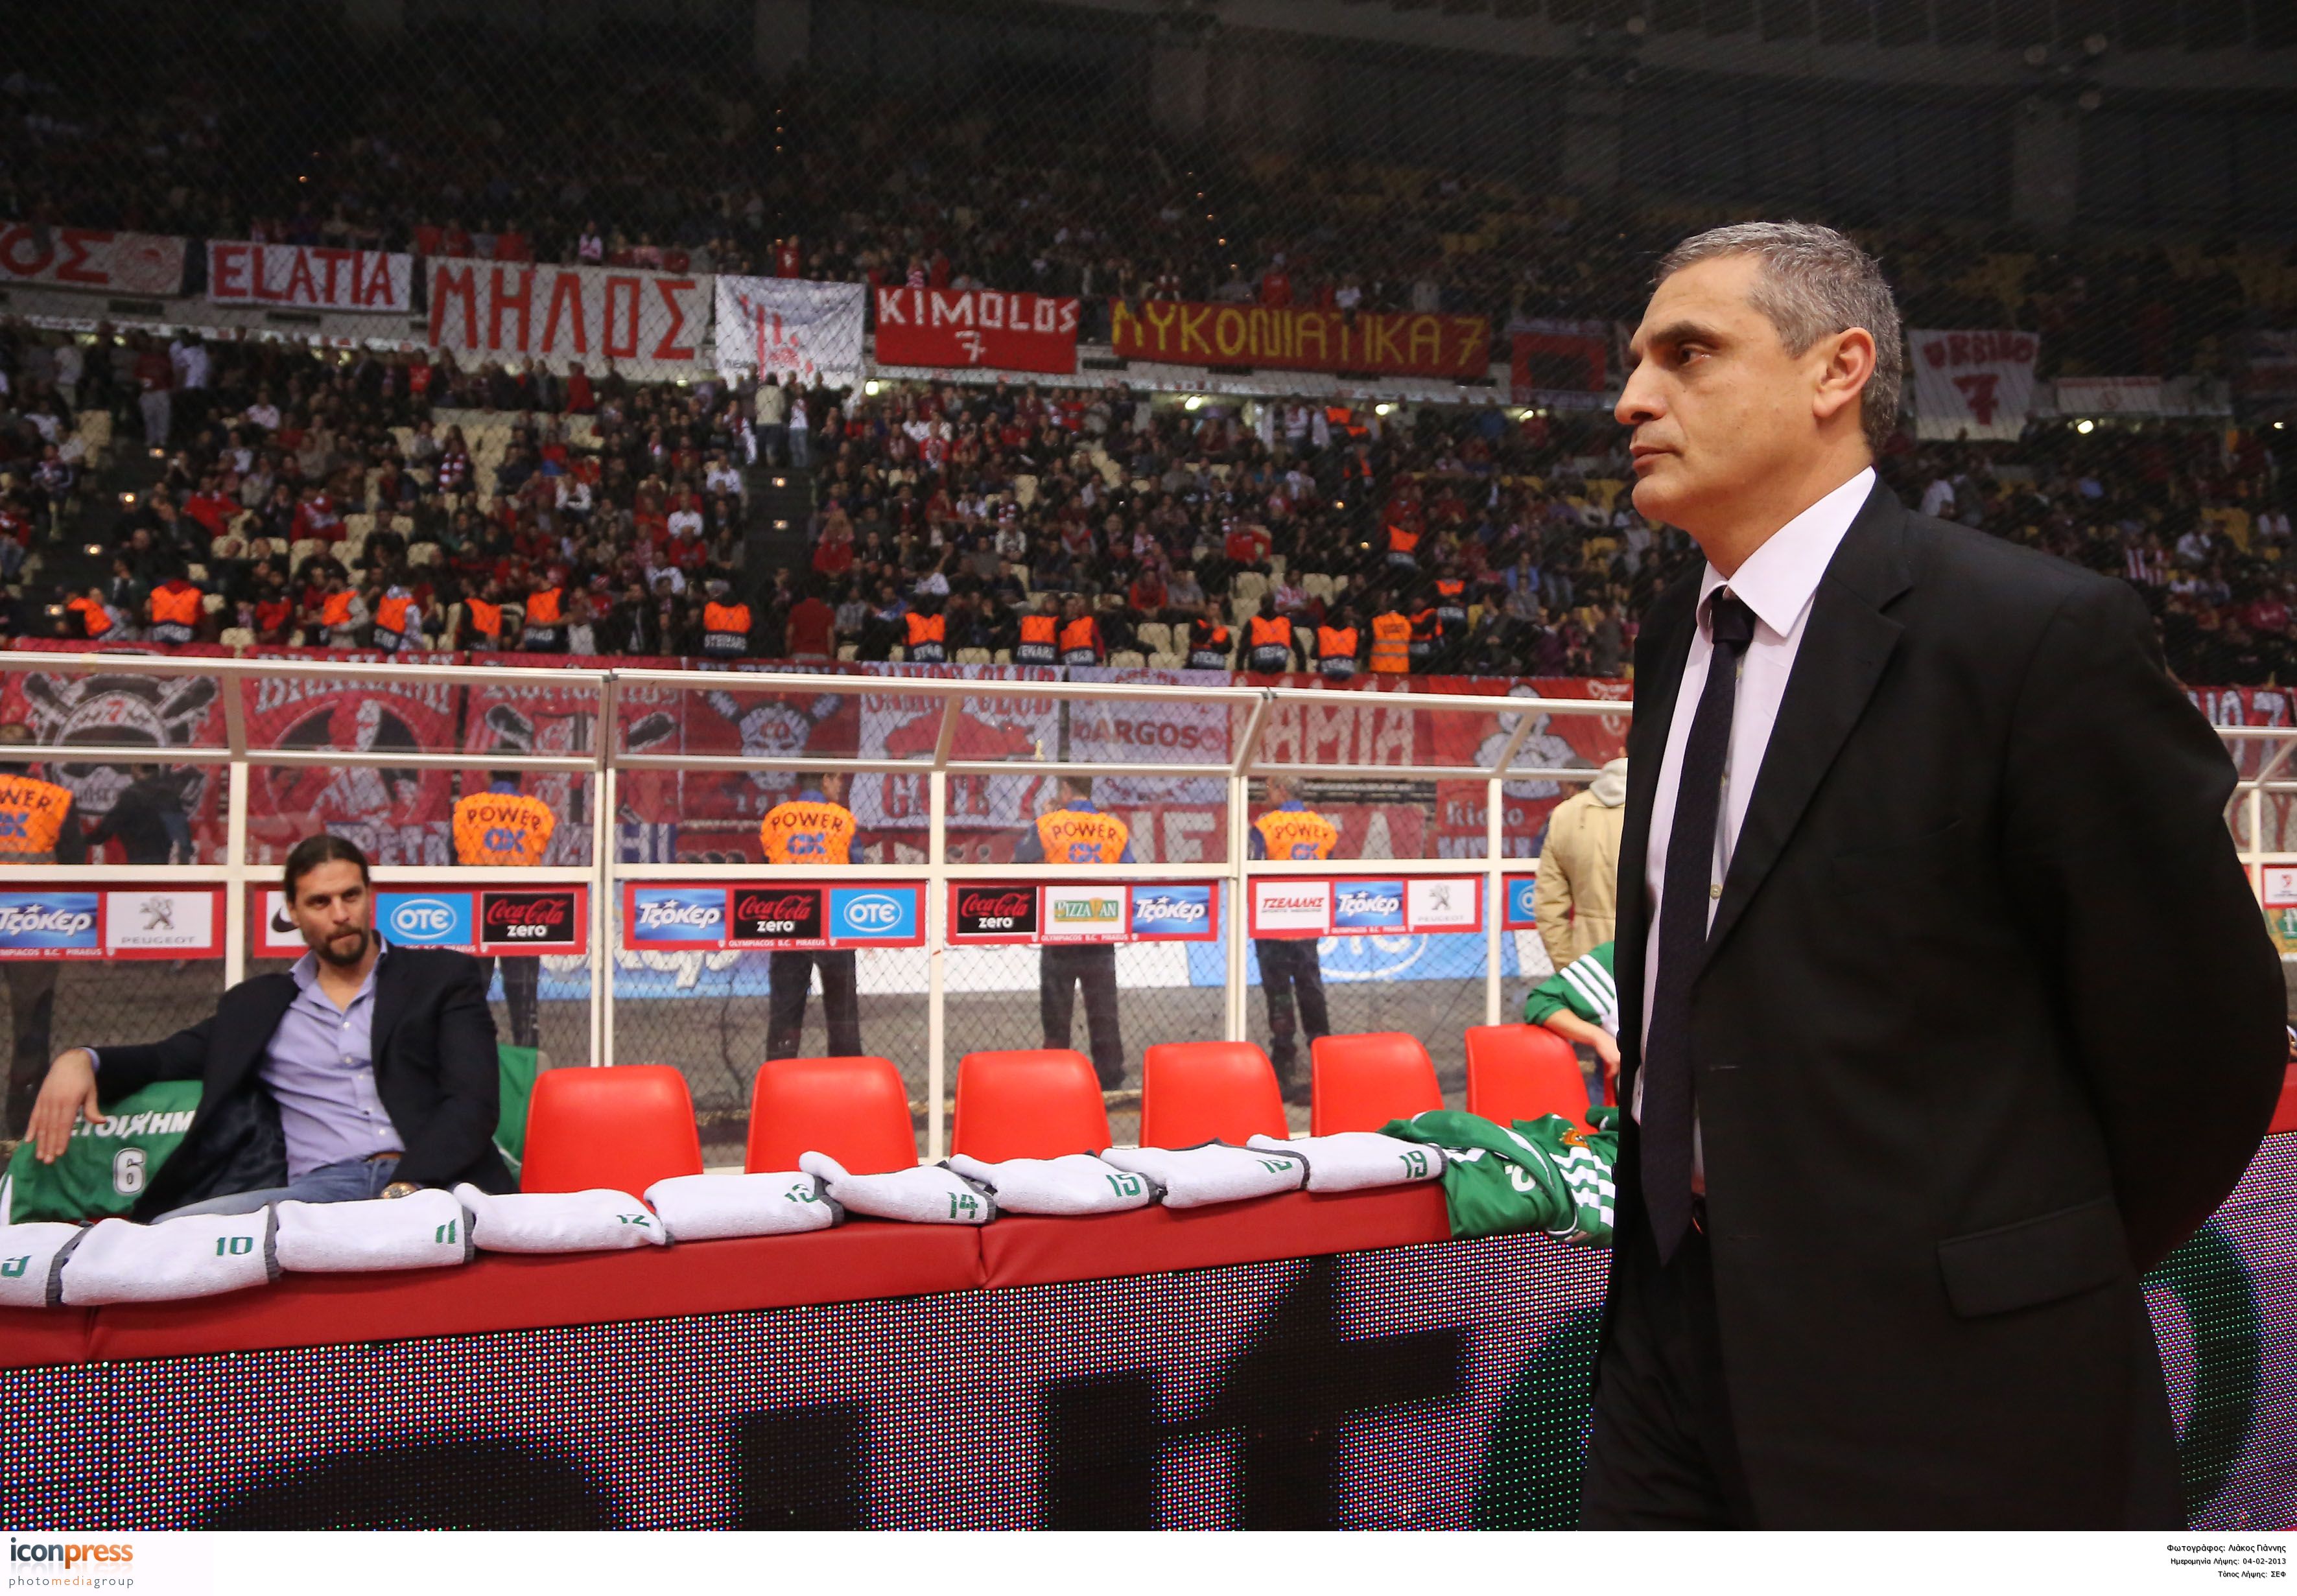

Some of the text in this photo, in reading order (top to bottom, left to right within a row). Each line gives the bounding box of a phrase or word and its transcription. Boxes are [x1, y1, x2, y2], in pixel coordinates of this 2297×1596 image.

[0, 222, 114, 283] ΟΣ
[213, 245, 394, 305] ELATIA
[429, 265, 696, 360] ΜΗΛΟΣ
[878, 288, 1080, 333] KIMOLOS
[954, 329, 987, 363] 7
[1452, 316, 1486, 367] 7
[1951, 373, 1999, 426] 7
[467, 806, 541, 830] POWER
[772, 812, 843, 832] POWER
[1052, 821, 1117, 840] POWER
[978, 916, 1013, 929] zero
[1057, 901, 1091, 917] PIZZA
[506, 923, 547, 938] zero
[756, 920, 795, 932] zero
[121, 935, 196, 945] PEUGEOT
[113, 1147, 146, 1196] 6
[1398, 1150, 1428, 1179] 19
[1105, 1172, 1142, 1197] 15
[947, 1191, 978, 1220] 14
[215, 1236, 253, 1256] 10
